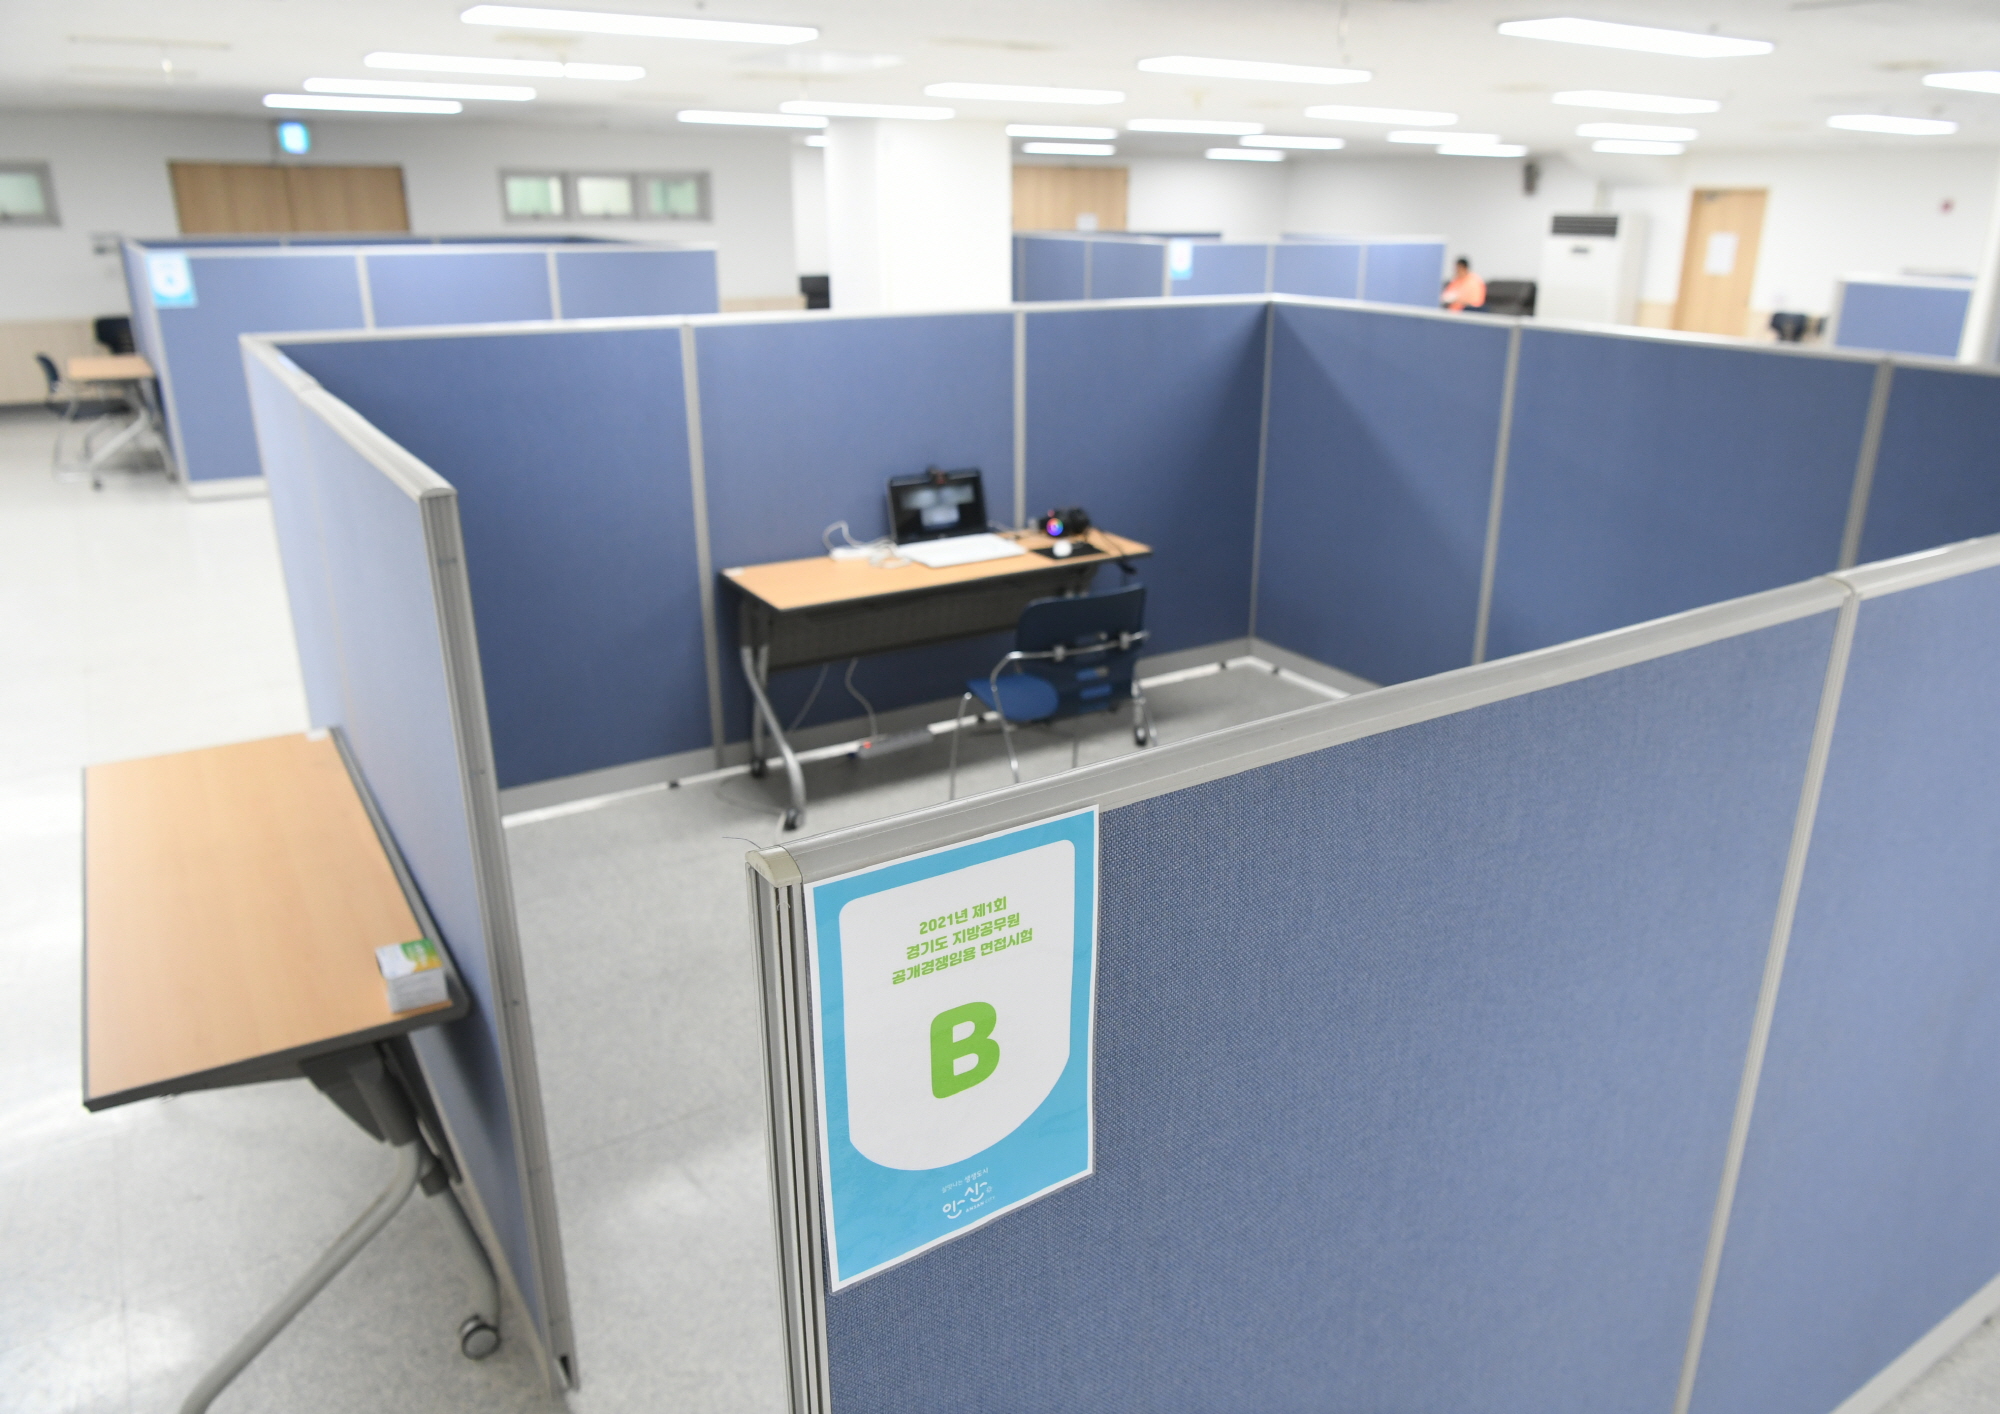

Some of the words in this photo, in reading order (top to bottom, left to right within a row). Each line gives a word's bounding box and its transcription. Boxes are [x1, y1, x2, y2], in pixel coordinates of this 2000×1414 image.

[906, 936, 948, 960] 경기도
[952, 913, 1020, 945] 지방공무원
[919, 908, 968, 935] 2021년
[972, 896, 1007, 919] 제1회
[892, 947, 976, 985] 공개경쟁임용
[980, 928, 1033, 956] 면접시험
[930, 1002, 1000, 1099] B
[943, 1182, 987, 1219] 안산
